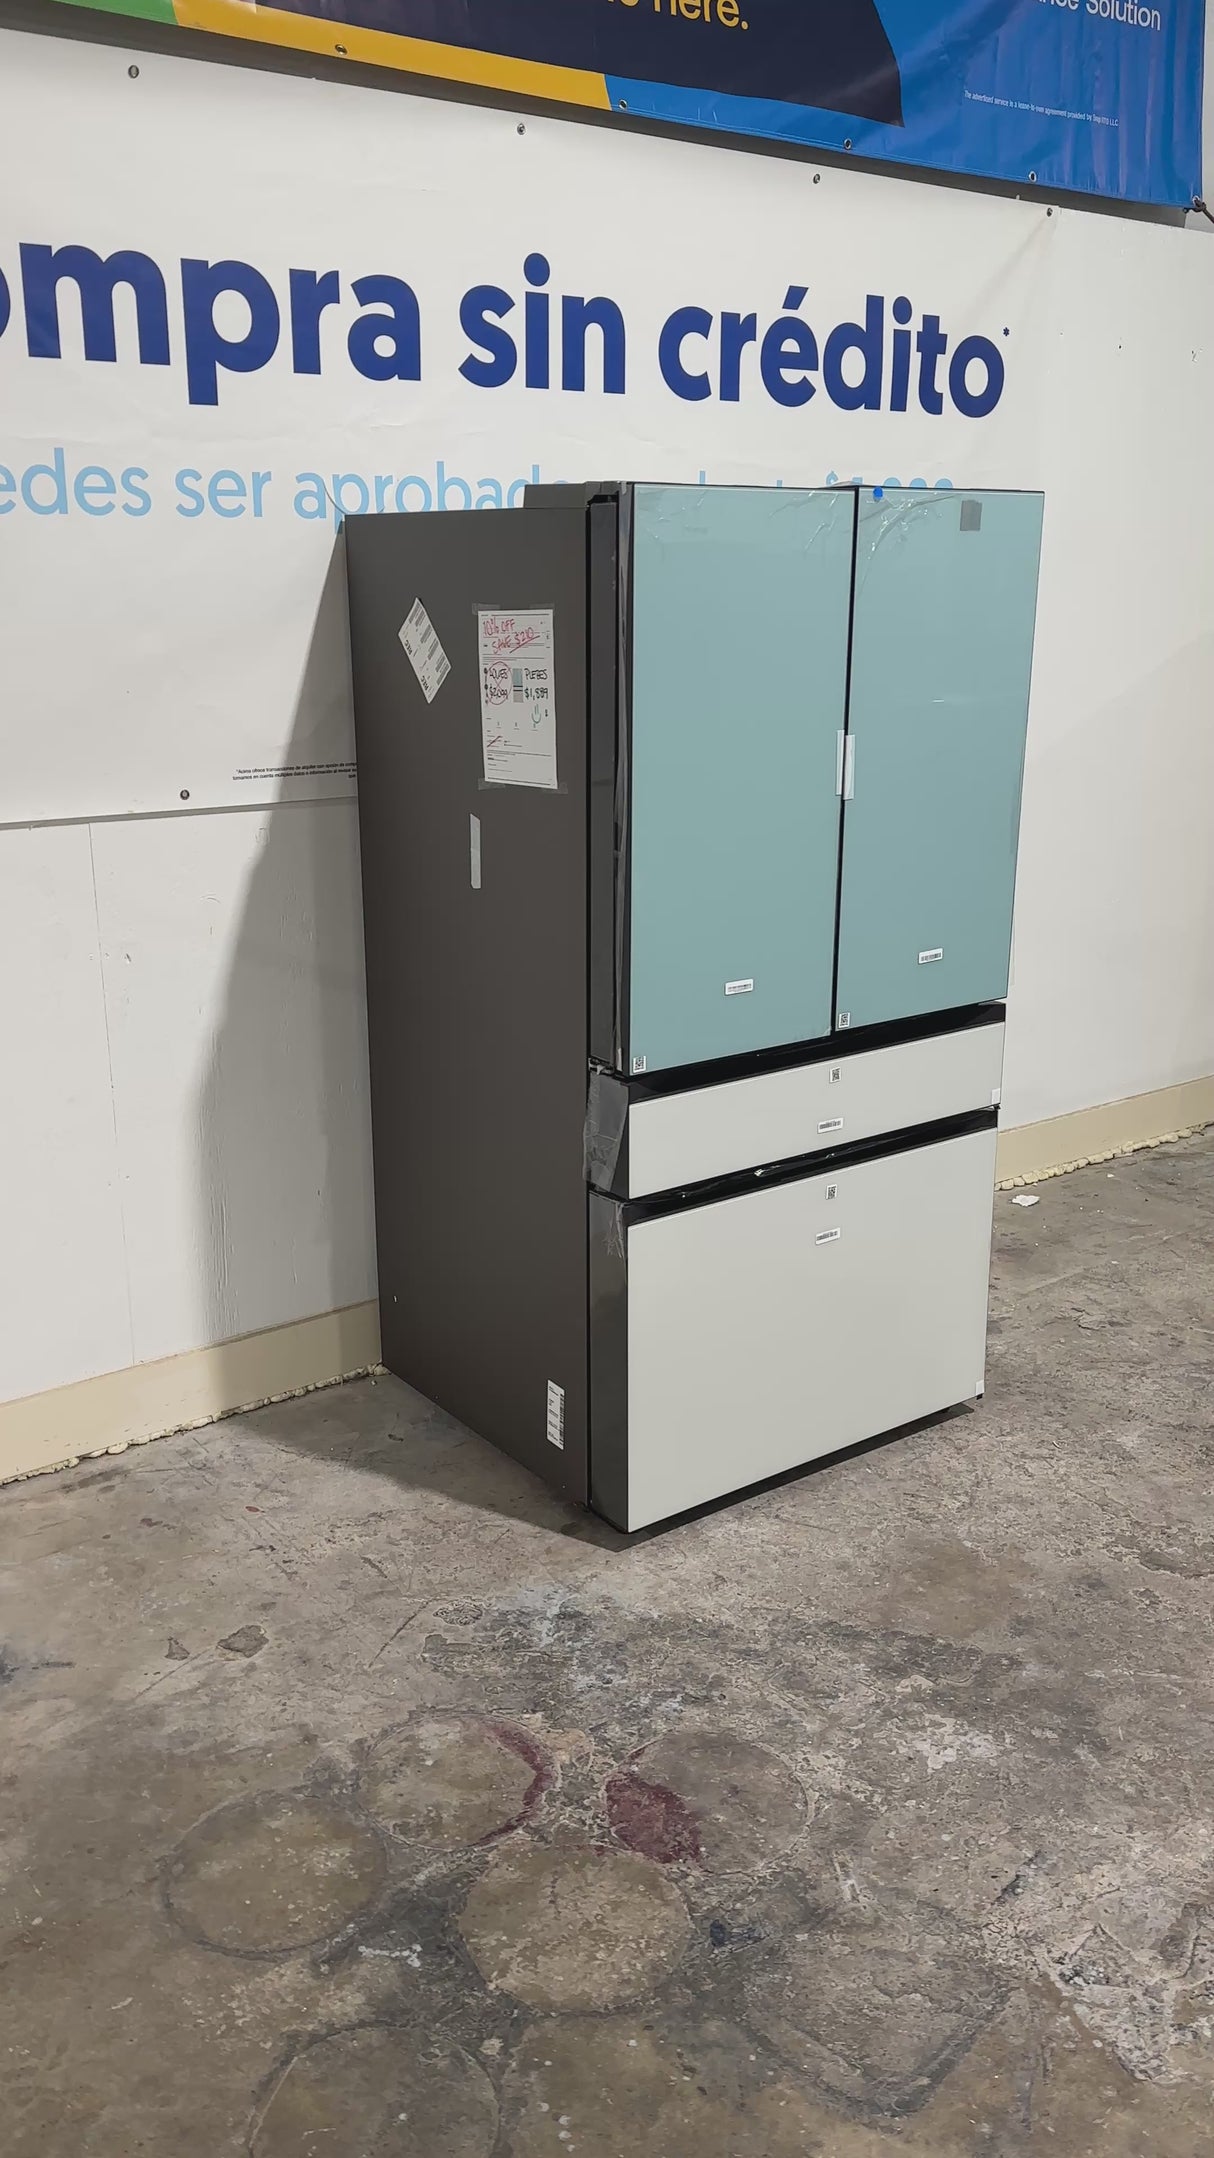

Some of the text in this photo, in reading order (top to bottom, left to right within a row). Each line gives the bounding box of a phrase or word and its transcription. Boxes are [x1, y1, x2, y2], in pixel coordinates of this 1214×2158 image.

[1086, 0, 1161, 31] Solution
[0, 243, 421, 406] mpra
[458, 253, 626, 394] sin
[175, 467, 272, 518] ser
